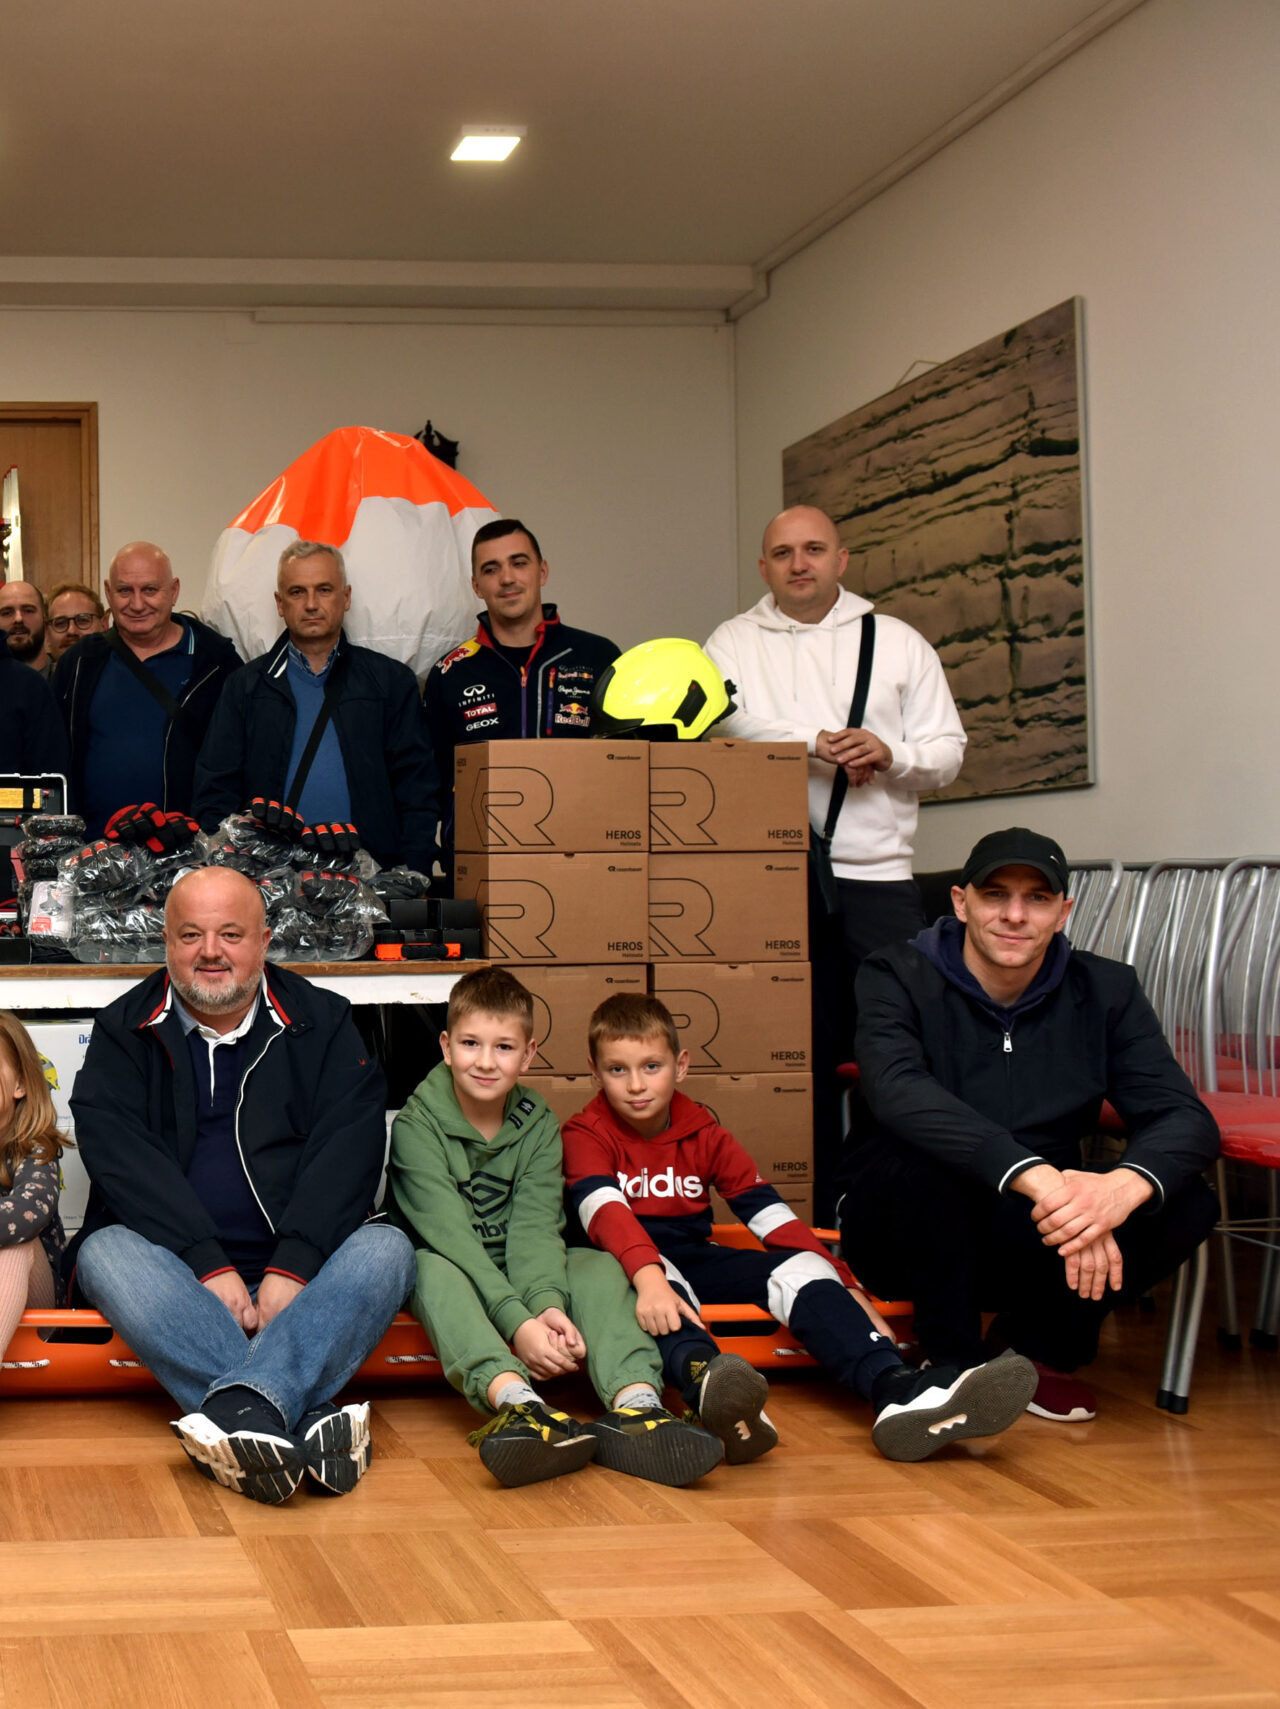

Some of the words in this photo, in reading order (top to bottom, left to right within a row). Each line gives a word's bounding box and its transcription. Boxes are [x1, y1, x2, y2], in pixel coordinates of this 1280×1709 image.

[458, 692, 496, 708] INFINITI
[465, 717, 500, 732] GEOX
[605, 830, 642, 840] HEROS
[767, 829, 804, 839] HEROS
[607, 941, 644, 951] HEROS
[765, 940, 801, 950] HEROS
[770, 1050, 806, 1061] HEROS
[773, 1161, 808, 1171] HEROS
